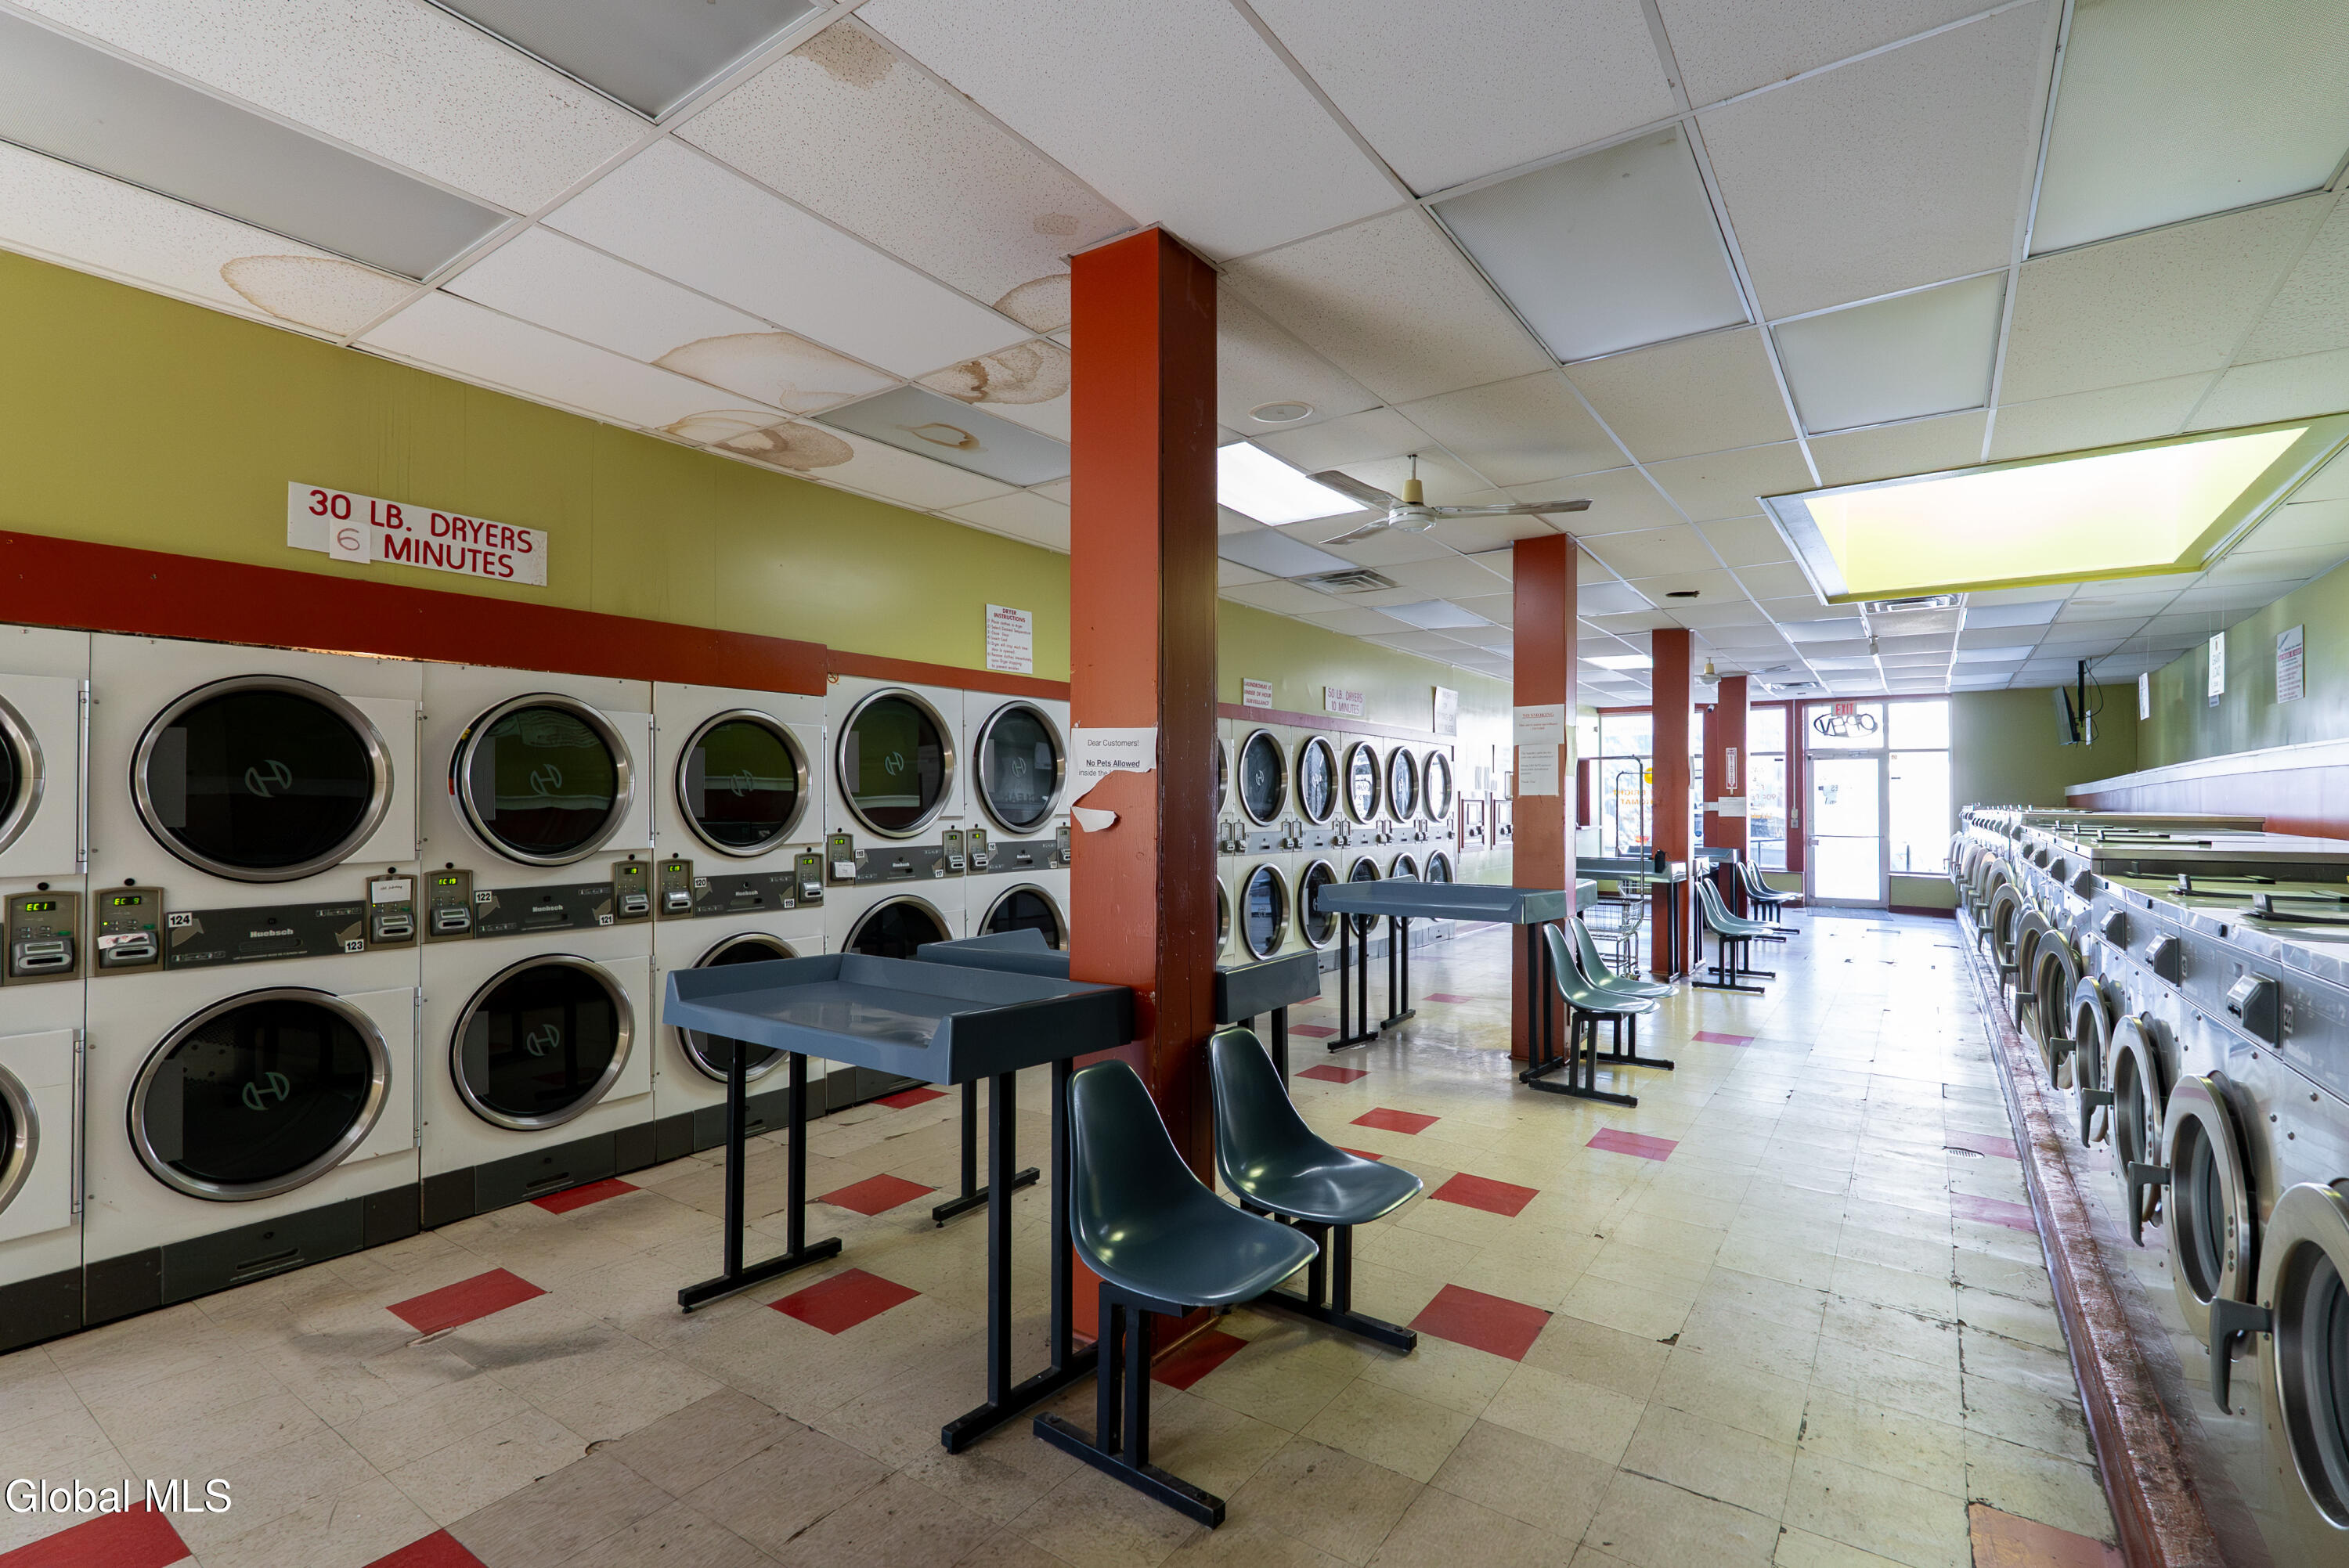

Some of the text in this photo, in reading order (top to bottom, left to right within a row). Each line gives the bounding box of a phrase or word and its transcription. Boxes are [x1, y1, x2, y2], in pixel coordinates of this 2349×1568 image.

[309, 489, 533, 553] 30 LB. DRYERS
[337, 527, 360, 551] 6
[384, 533, 514, 578] MINUTES
[994, 613, 1026, 623] INSTRUCTIONS
[1345, 690, 1363, 703] DRYERS
[1331, 701, 1360, 714] 10 MINUTES
[1835, 703, 1854, 716] EXIT
[170, 914, 191, 926] 124
[250, 928, 294, 939] Huebsch
[346, 941, 363, 951] 123
